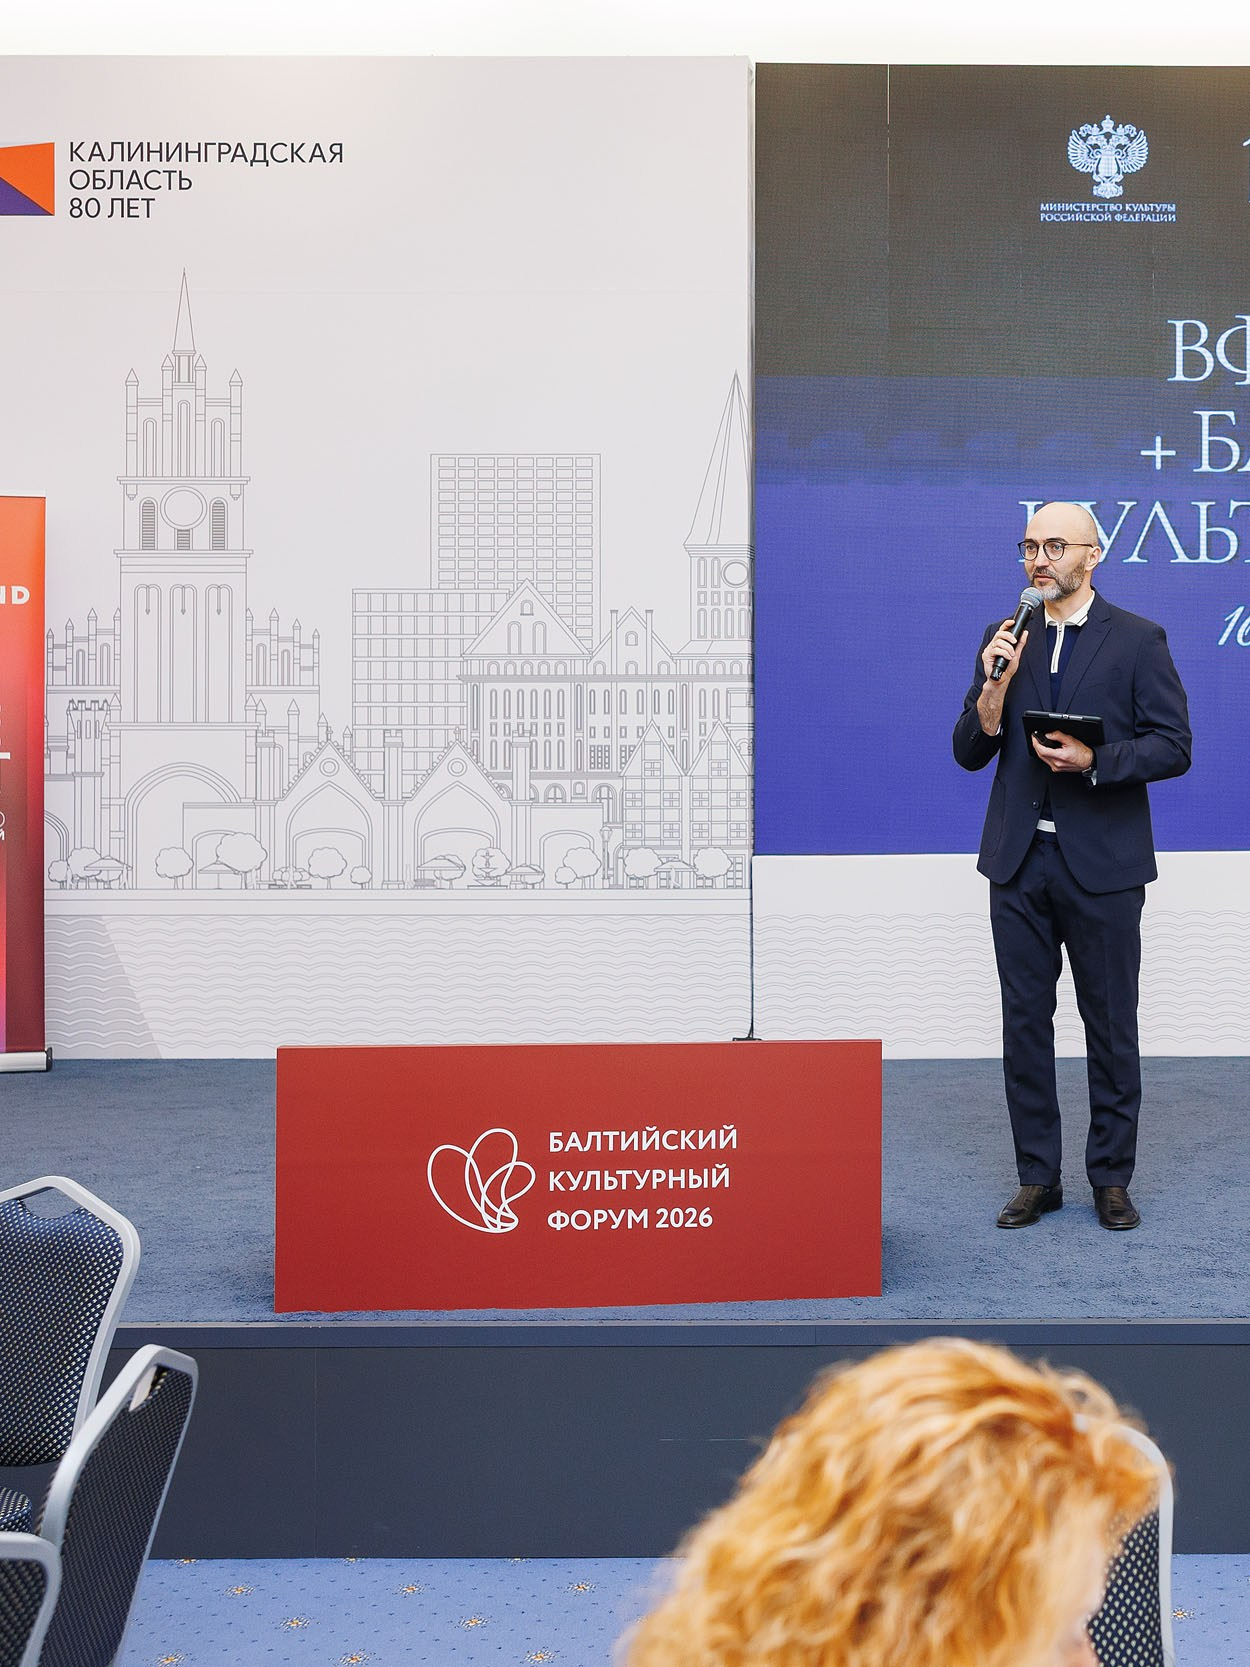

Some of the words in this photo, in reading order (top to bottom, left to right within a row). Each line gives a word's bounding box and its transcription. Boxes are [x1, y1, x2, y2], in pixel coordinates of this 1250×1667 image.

[70, 141, 343, 168] КАЛИНИНГРАДСКАЯ
[69, 169, 193, 191] ОБЛАСТЬ
[69, 197, 101, 219] 80
[107, 197, 156, 219] ЛЕТ
[1040, 202, 1123, 212] МИНИСТЕРСТВО
[1125, 203, 1176, 213] КУЛЬТУРЫ
[1040, 212, 1112, 222] РОССИЙСКОЙ
[1114, 213, 1176, 222] ФЕДЕРАЦИИ
[1140, 435, 1177, 470] +
[549, 1124, 737, 1153] БАЛТИЙСКИЙ
[549, 1163, 730, 1192] КУЛЬТУРНЫЙ
[547, 1208, 649, 1231] ФОРУМ
[655, 1206, 713, 1228] 2026
